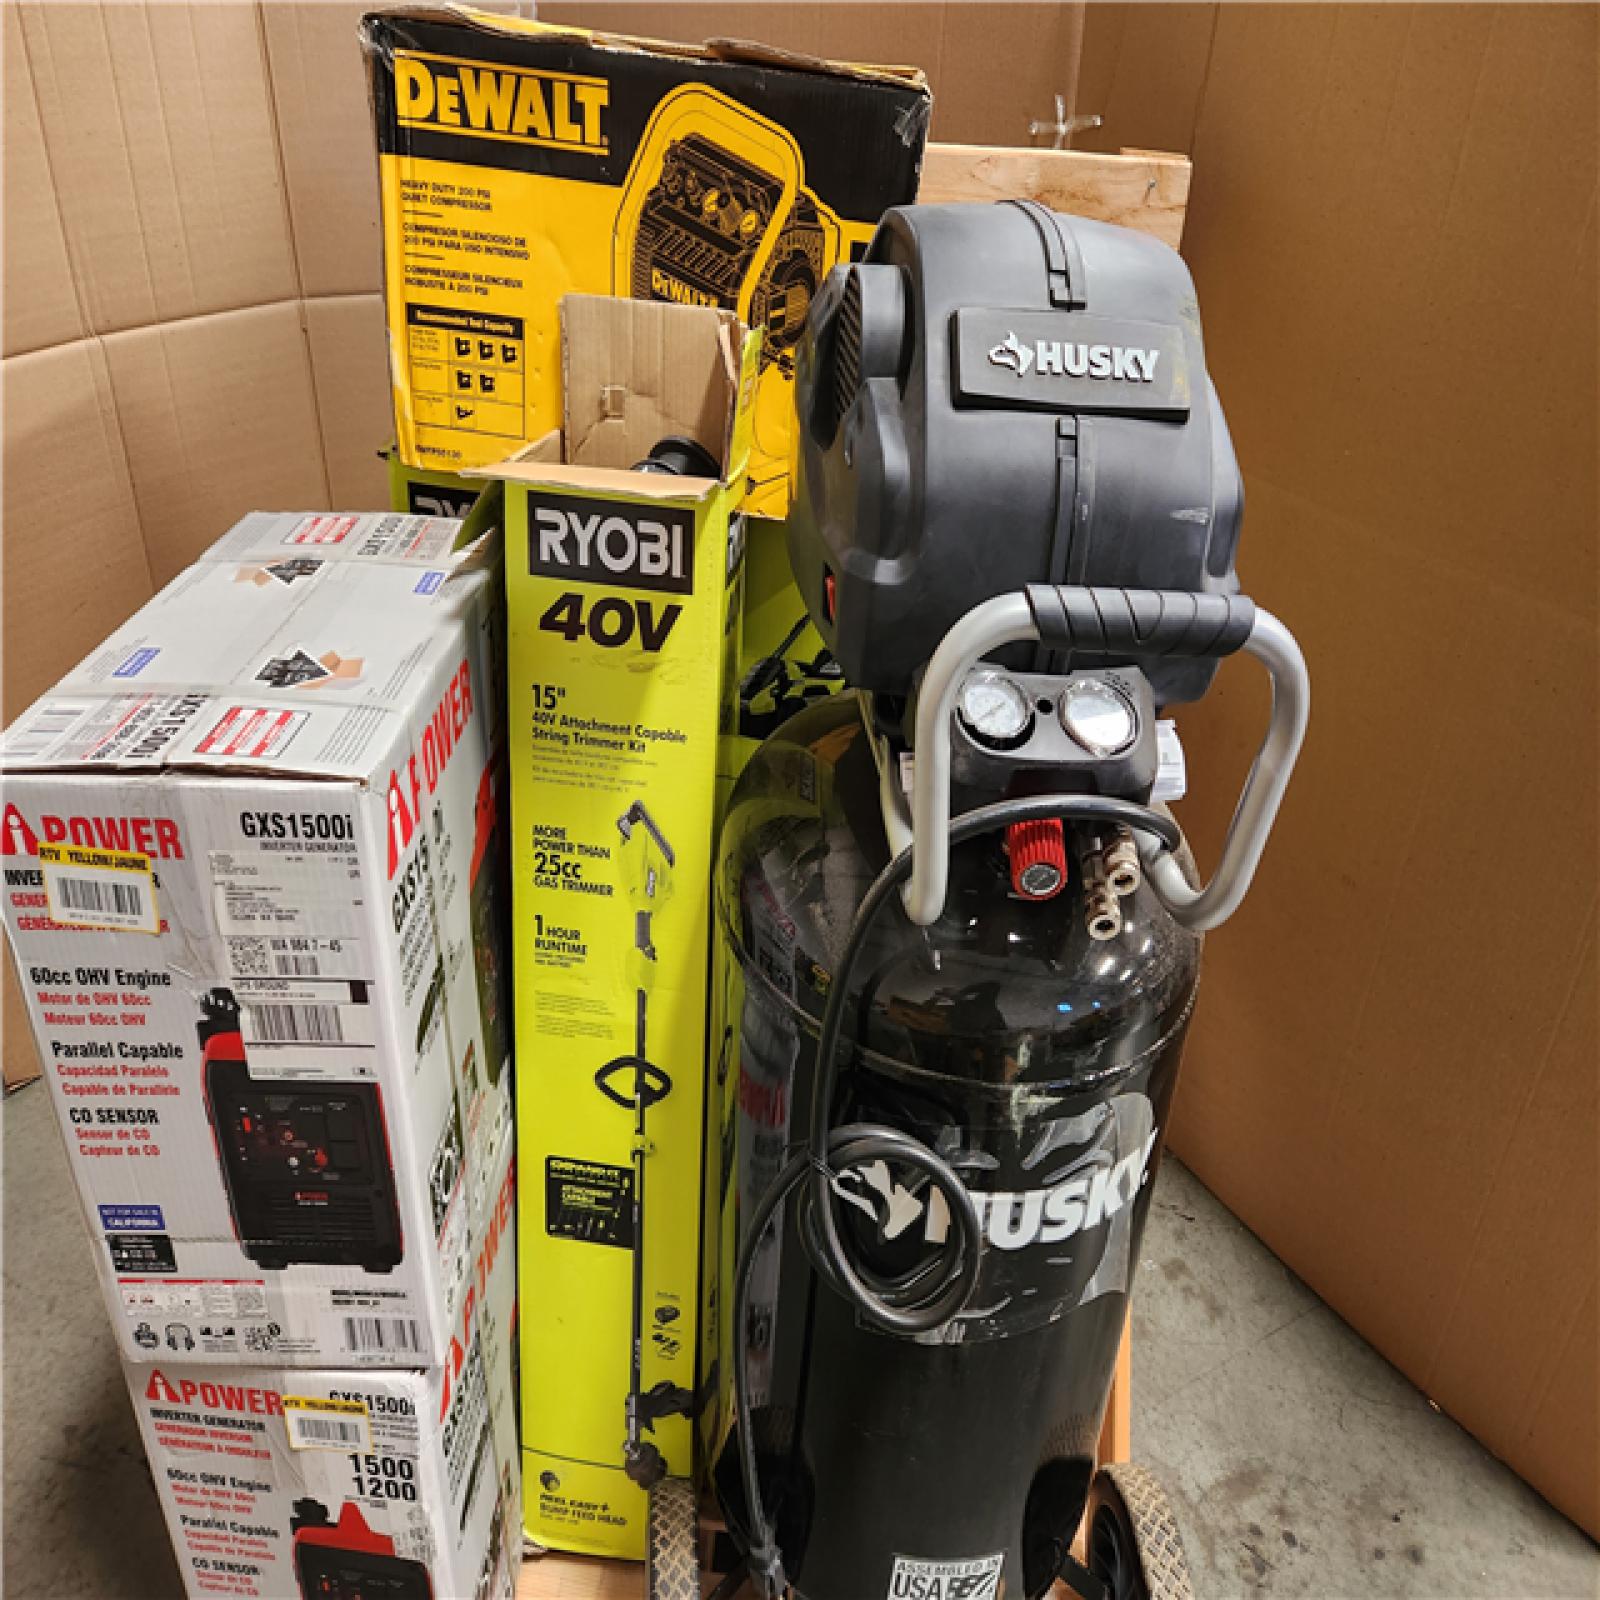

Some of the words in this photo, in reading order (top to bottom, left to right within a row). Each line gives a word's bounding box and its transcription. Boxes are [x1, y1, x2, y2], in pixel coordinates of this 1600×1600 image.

[1034, 341, 1160, 383] HUSKY
[534, 507, 686, 579] RYOBI
[539, 592, 683, 653] 40V
[532, 726, 570, 745] String
[573, 732, 625, 751] Trimmer
[629, 740, 646, 753] Kit
[560, 714, 631, 736] Attachment
[635, 725, 688, 744] Capable
[239, 811, 354, 840] GXS1500i
[533, 851, 583, 880] 25cc
[561, 879, 614, 896] TRIMMER
[534, 936, 587, 956] RUNTIME
[114, 968, 171, 991] Engine
[51, 1040, 115, 1059] Parallel
[117, 1041, 183, 1062] Capable
[94, 1107, 160, 1125] SENSOR
[347, 1452, 414, 1481] 1500
[352, 1474, 417, 1502] 1200
